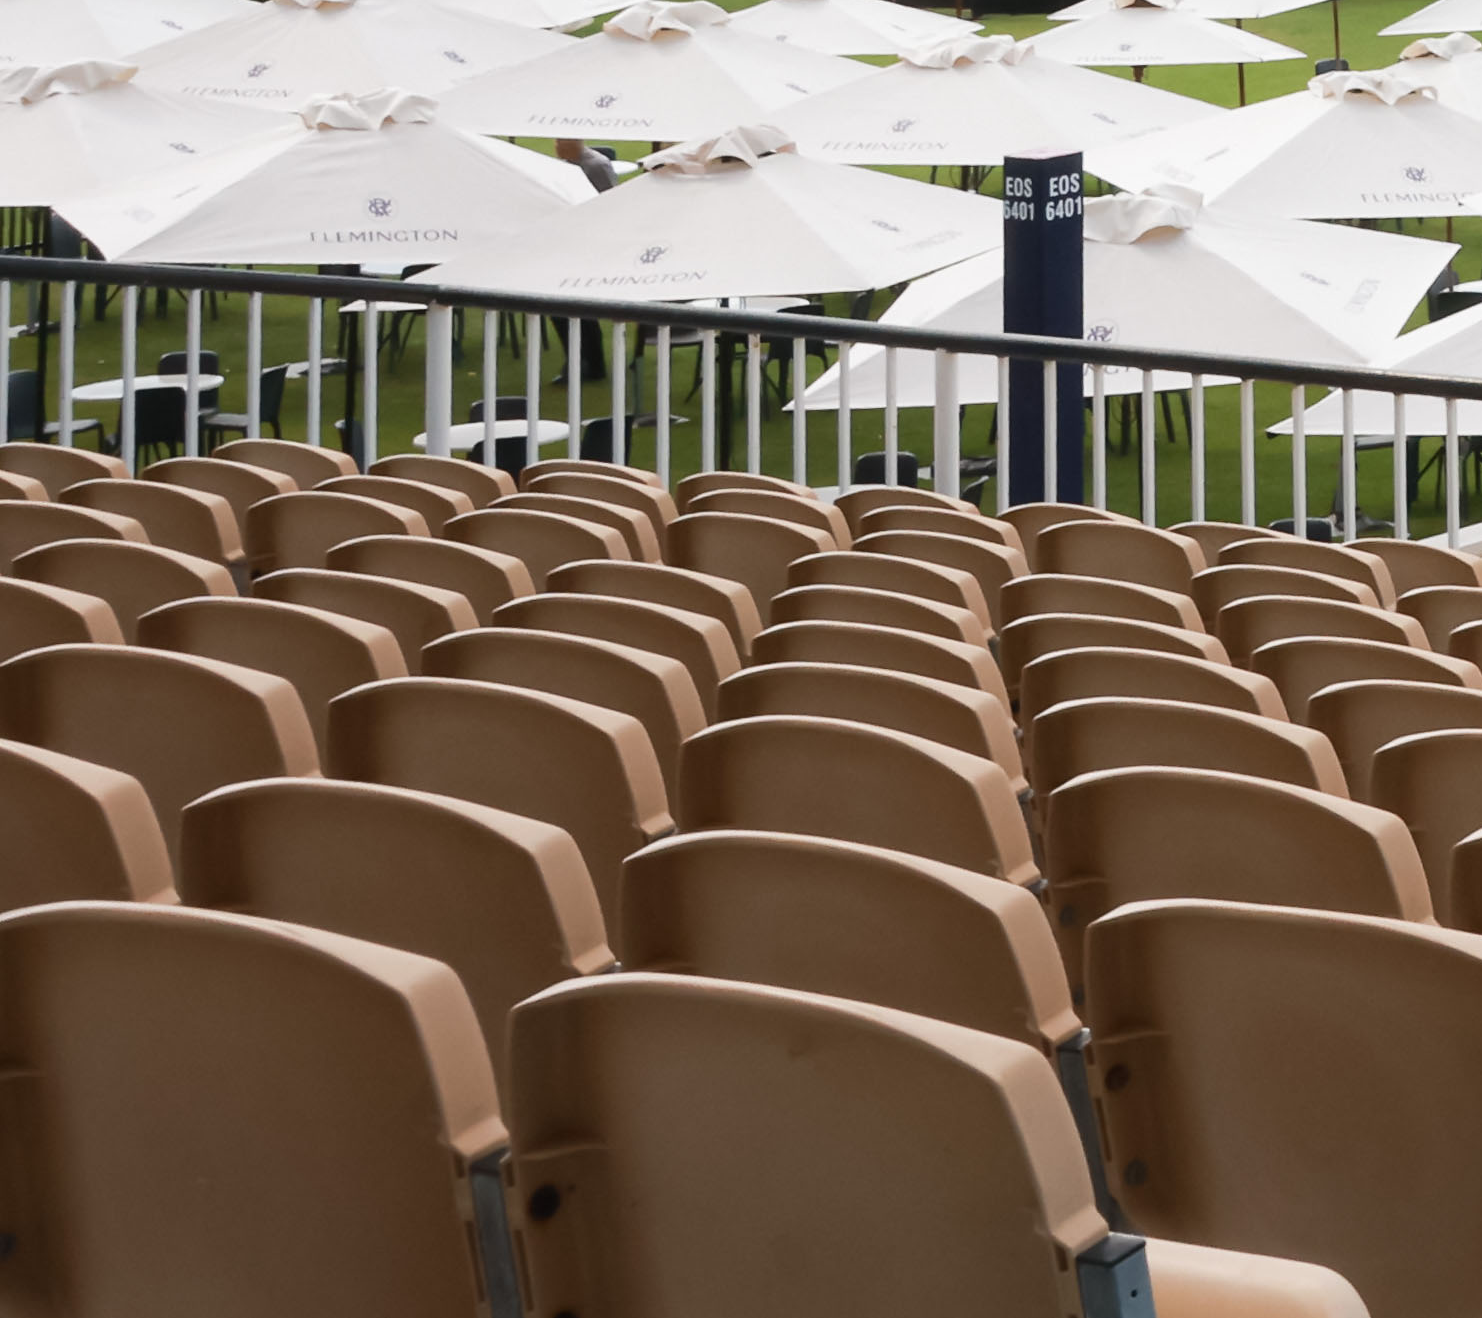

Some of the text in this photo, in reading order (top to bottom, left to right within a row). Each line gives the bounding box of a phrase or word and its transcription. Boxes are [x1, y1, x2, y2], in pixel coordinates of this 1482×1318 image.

[1005, 176, 1032, 197] EOS
[1049, 173, 1080, 197] EOS
[1003, 200, 1034, 221] 6401
[1045, 196, 1082, 221] 6401
[309, 229, 460, 243] FLEMINGTON
